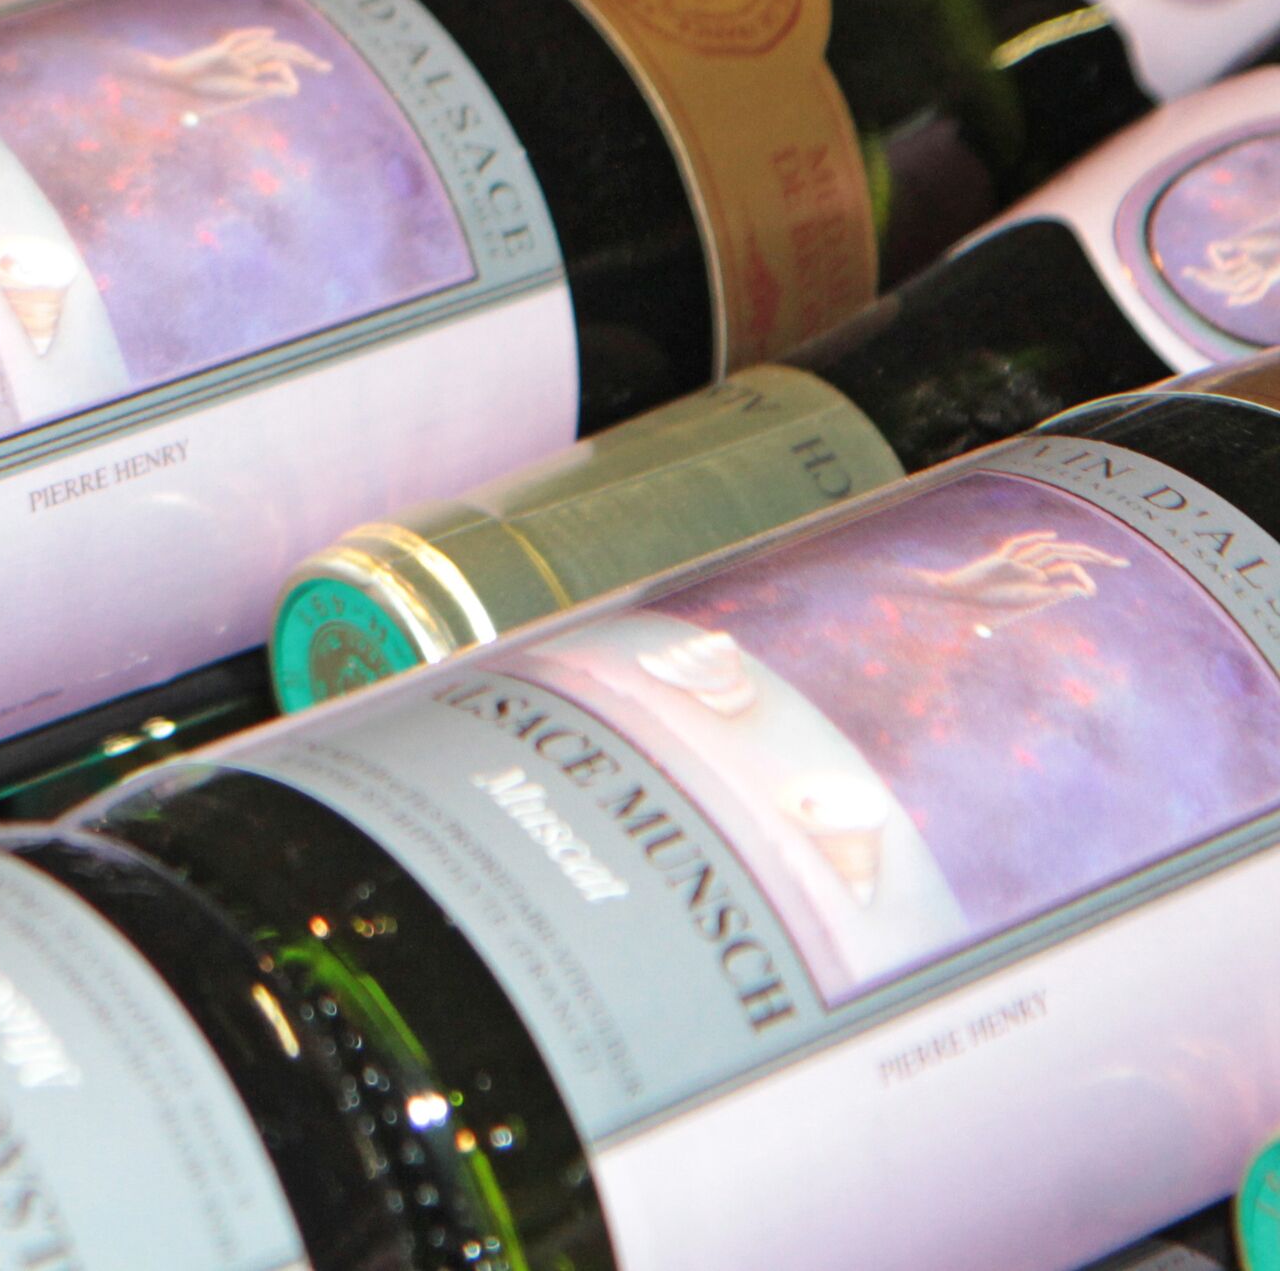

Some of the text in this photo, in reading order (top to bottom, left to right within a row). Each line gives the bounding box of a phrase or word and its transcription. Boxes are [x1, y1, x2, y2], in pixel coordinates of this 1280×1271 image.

[27, 438, 192, 515] PIERRE HENRY
[1033, 444, 1136, 480] VIN
[597, 784, 799, 1036] MUNSCH
